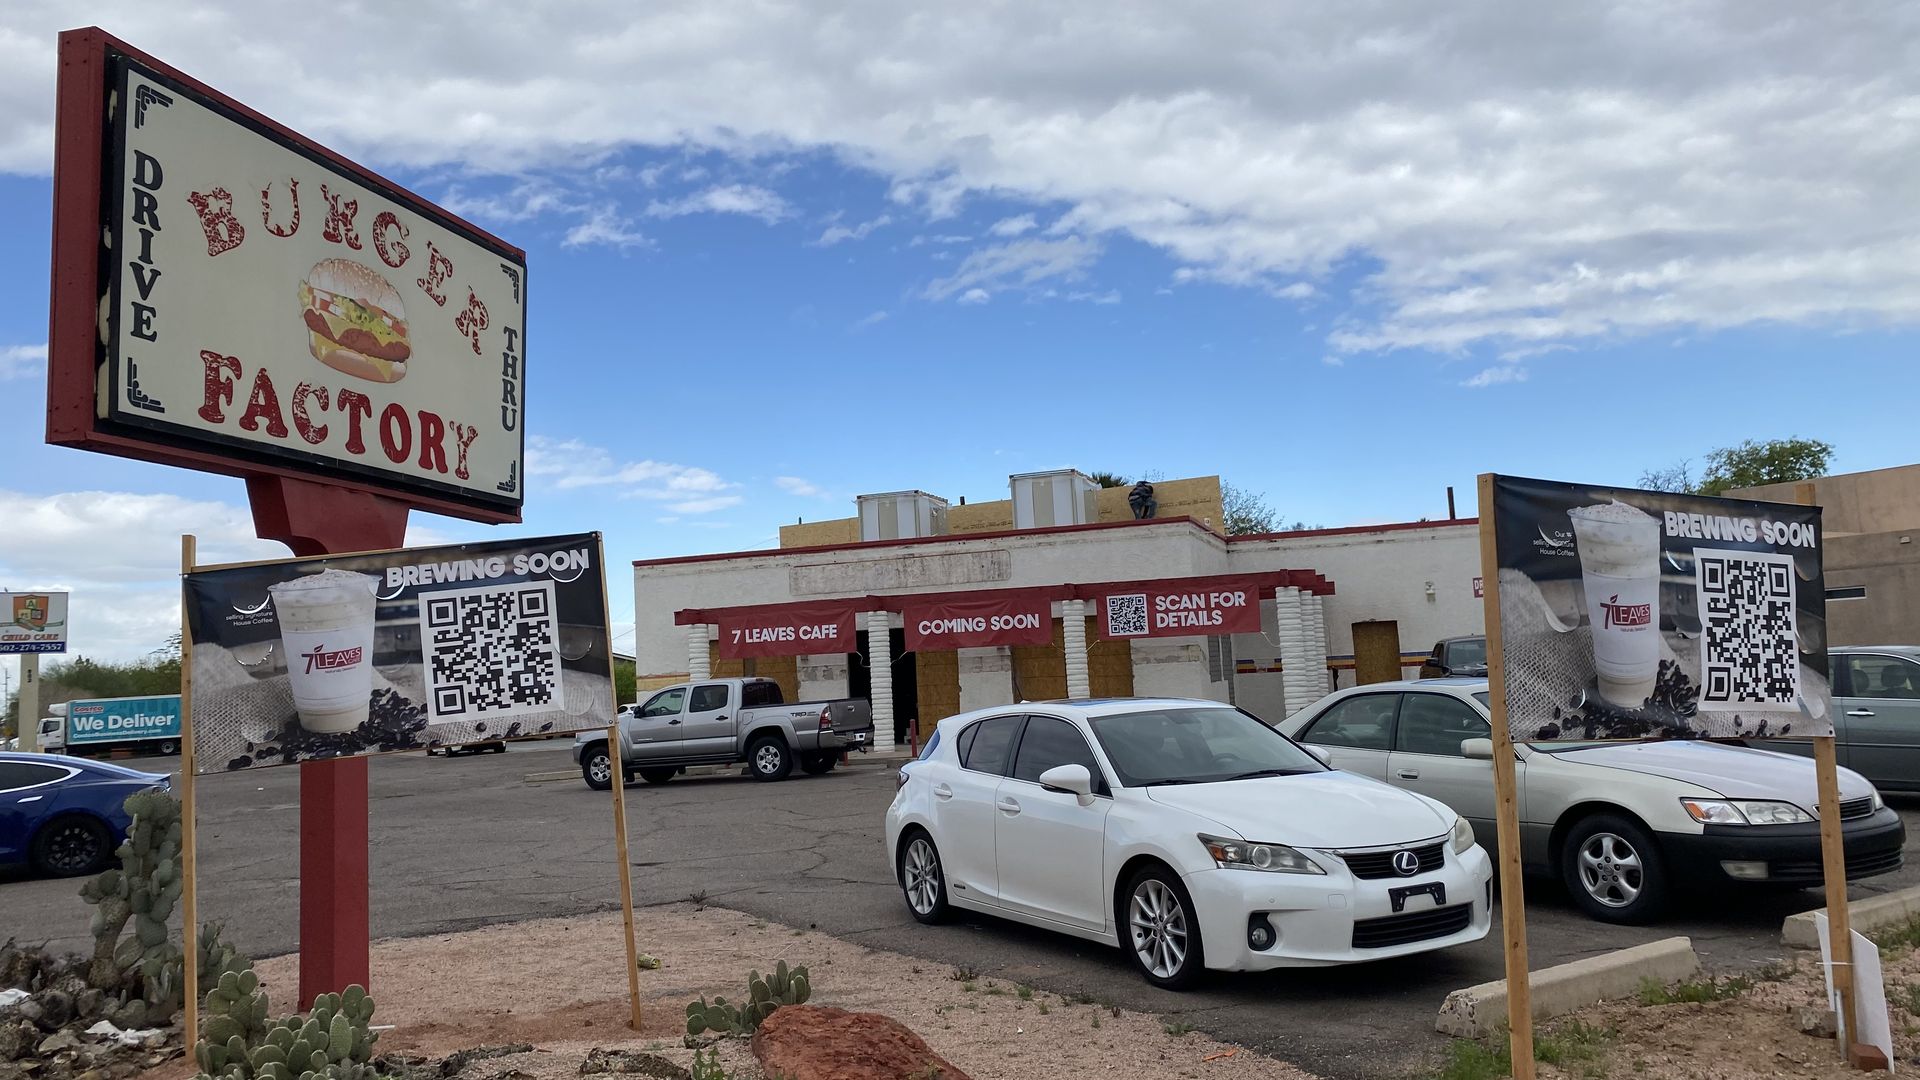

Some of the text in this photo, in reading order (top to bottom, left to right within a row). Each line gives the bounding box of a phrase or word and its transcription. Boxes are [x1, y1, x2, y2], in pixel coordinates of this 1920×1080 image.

[131, 150, 164, 342] DRIVE
[187, 177, 490, 356] BURGER
[502, 327, 519, 432] THRU
[198, 349, 479, 481] FACTORY
[1664, 511, 1816, 549] BREWING SOON
[1556, 548, 1575, 557] Coffee
[386, 548, 590, 589] BREWING SOON
[1155, 591, 1246, 612] SCAN FOR
[252, 617, 274, 625] Coffee
[918, 613, 1040, 635] COMING SOON
[1156, 610, 1223, 628] DETAILS
[1612, 604, 1650, 625] LEAVES
[731, 623, 838, 644] 7 LEAVES CAFE
[315, 648, 361, 668] LEAVES
[73, 713, 175, 731] We Deliver
